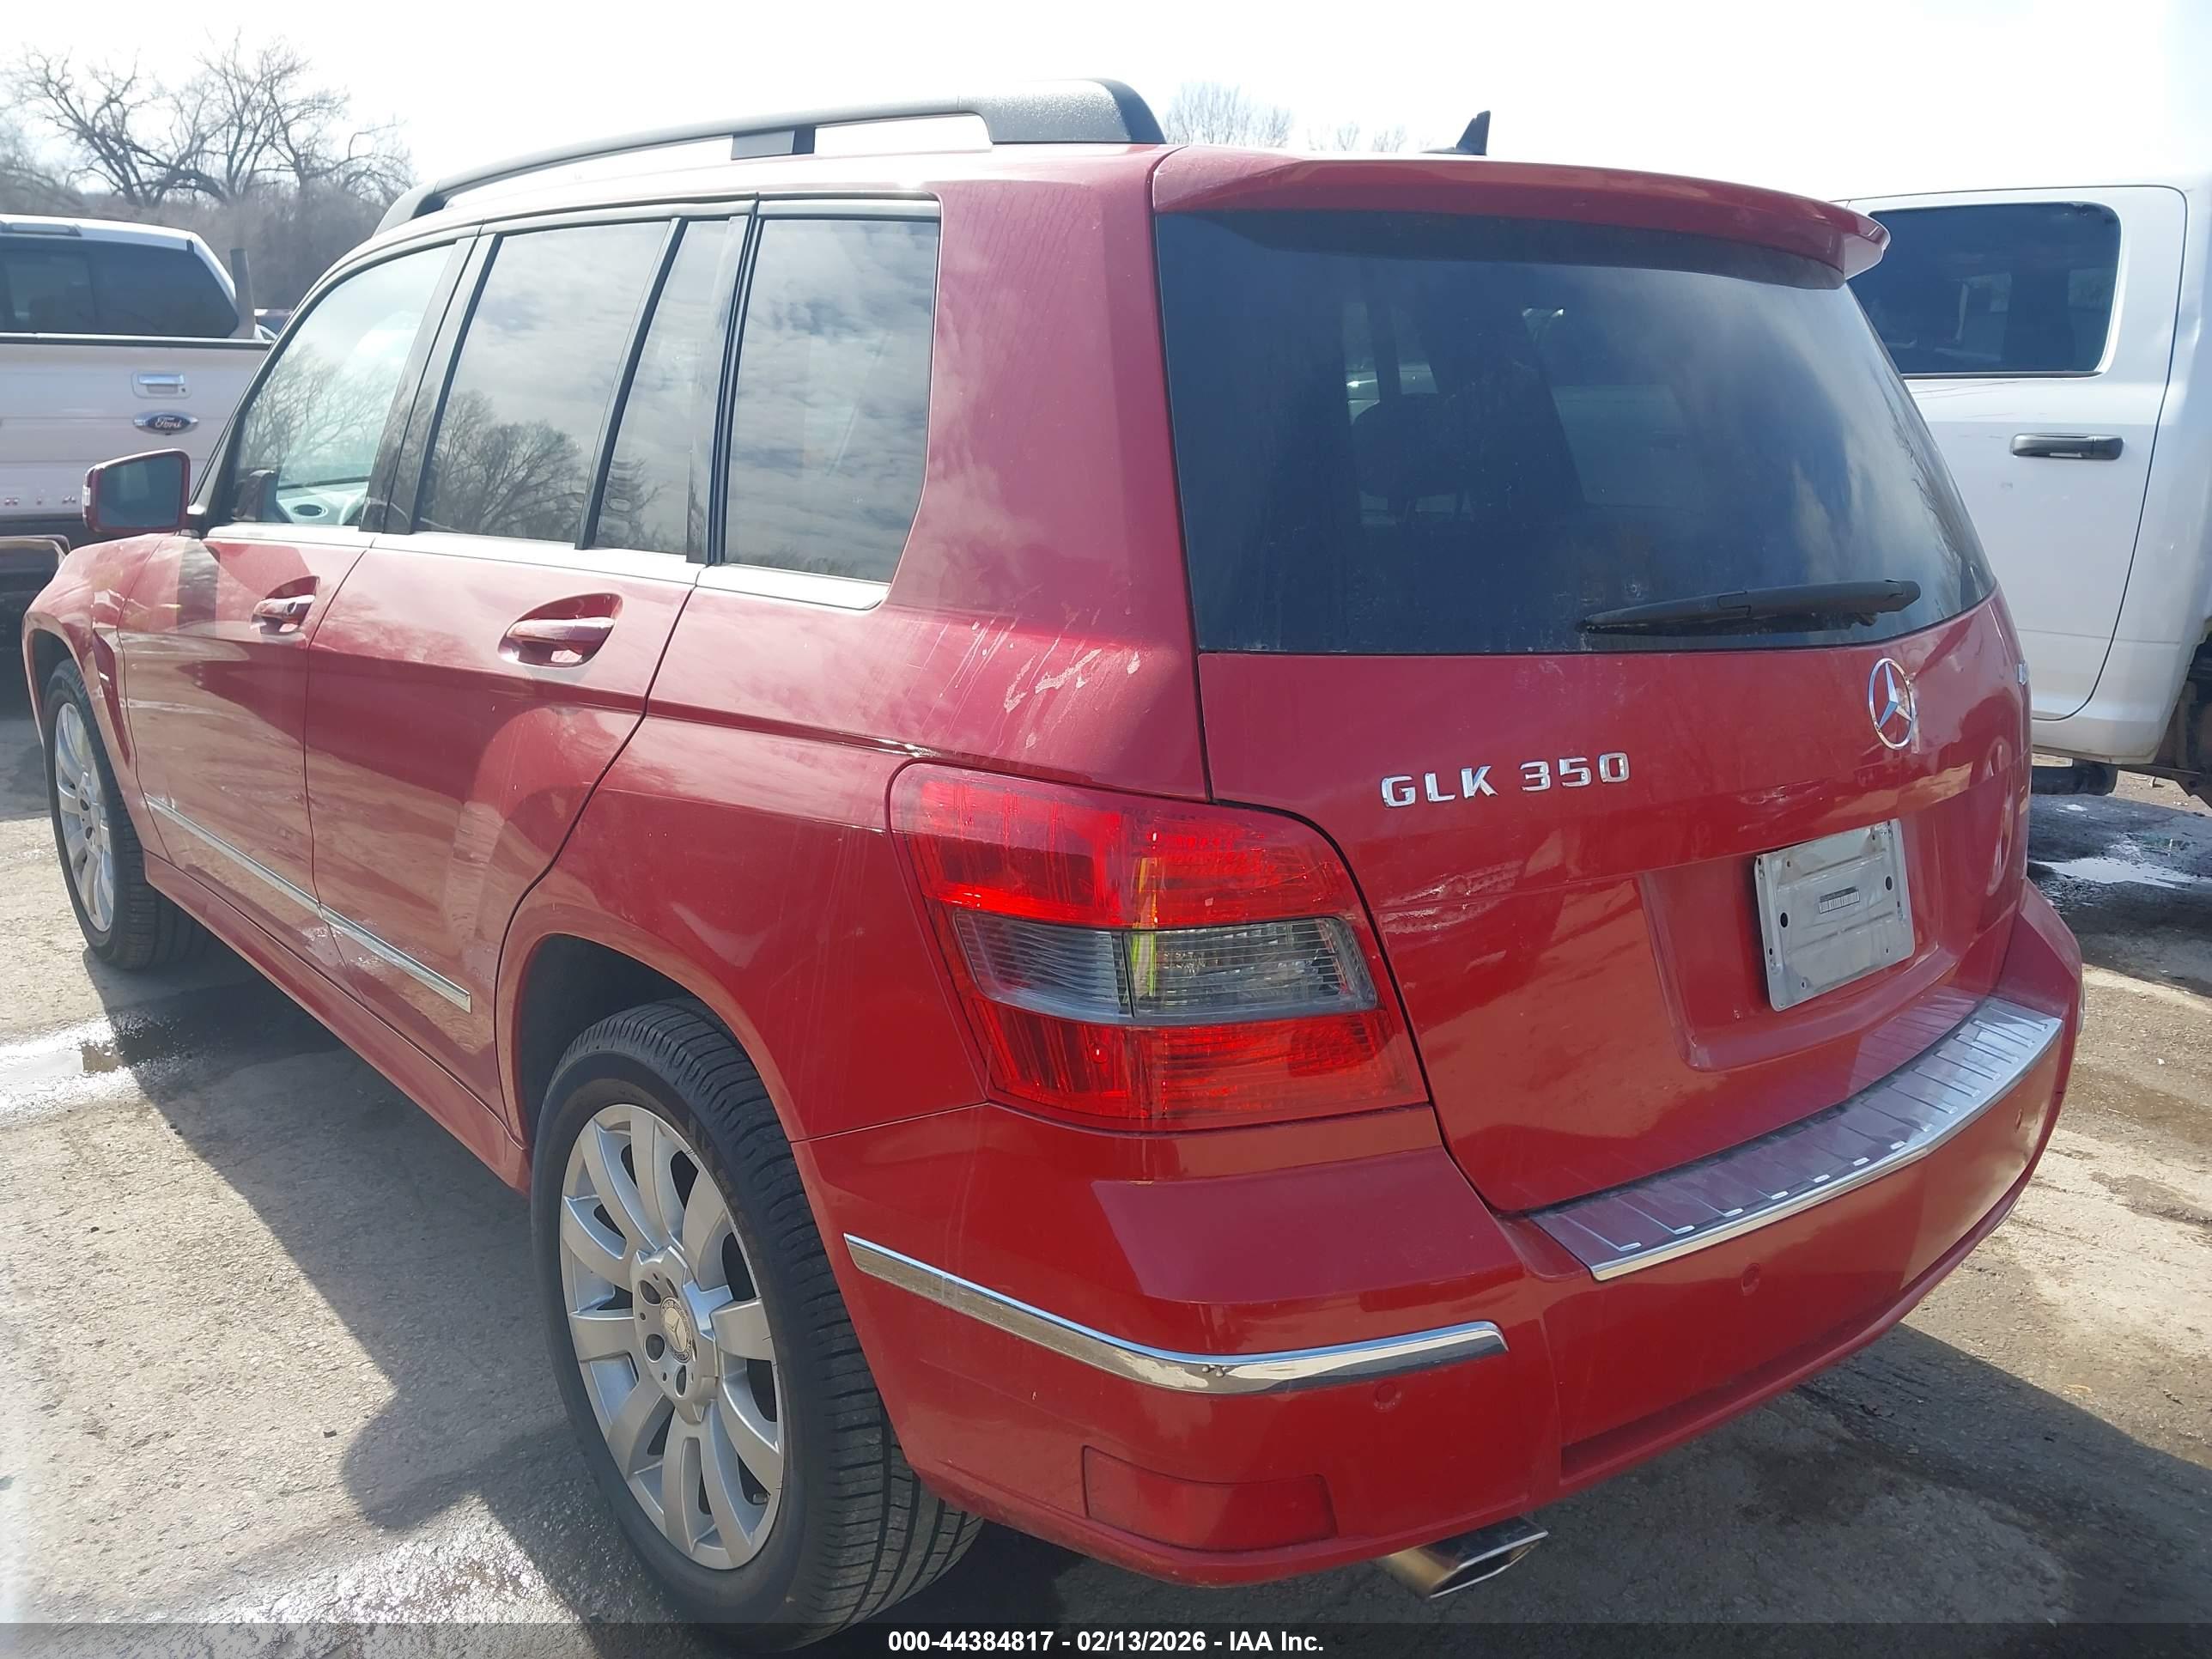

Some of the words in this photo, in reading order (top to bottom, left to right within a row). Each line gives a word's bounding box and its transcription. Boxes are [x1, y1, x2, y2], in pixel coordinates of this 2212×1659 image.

[155, 416, 183, 428] Ford
[1381, 765, 1499, 808] GLK
[1519, 751, 1631, 792] 350
